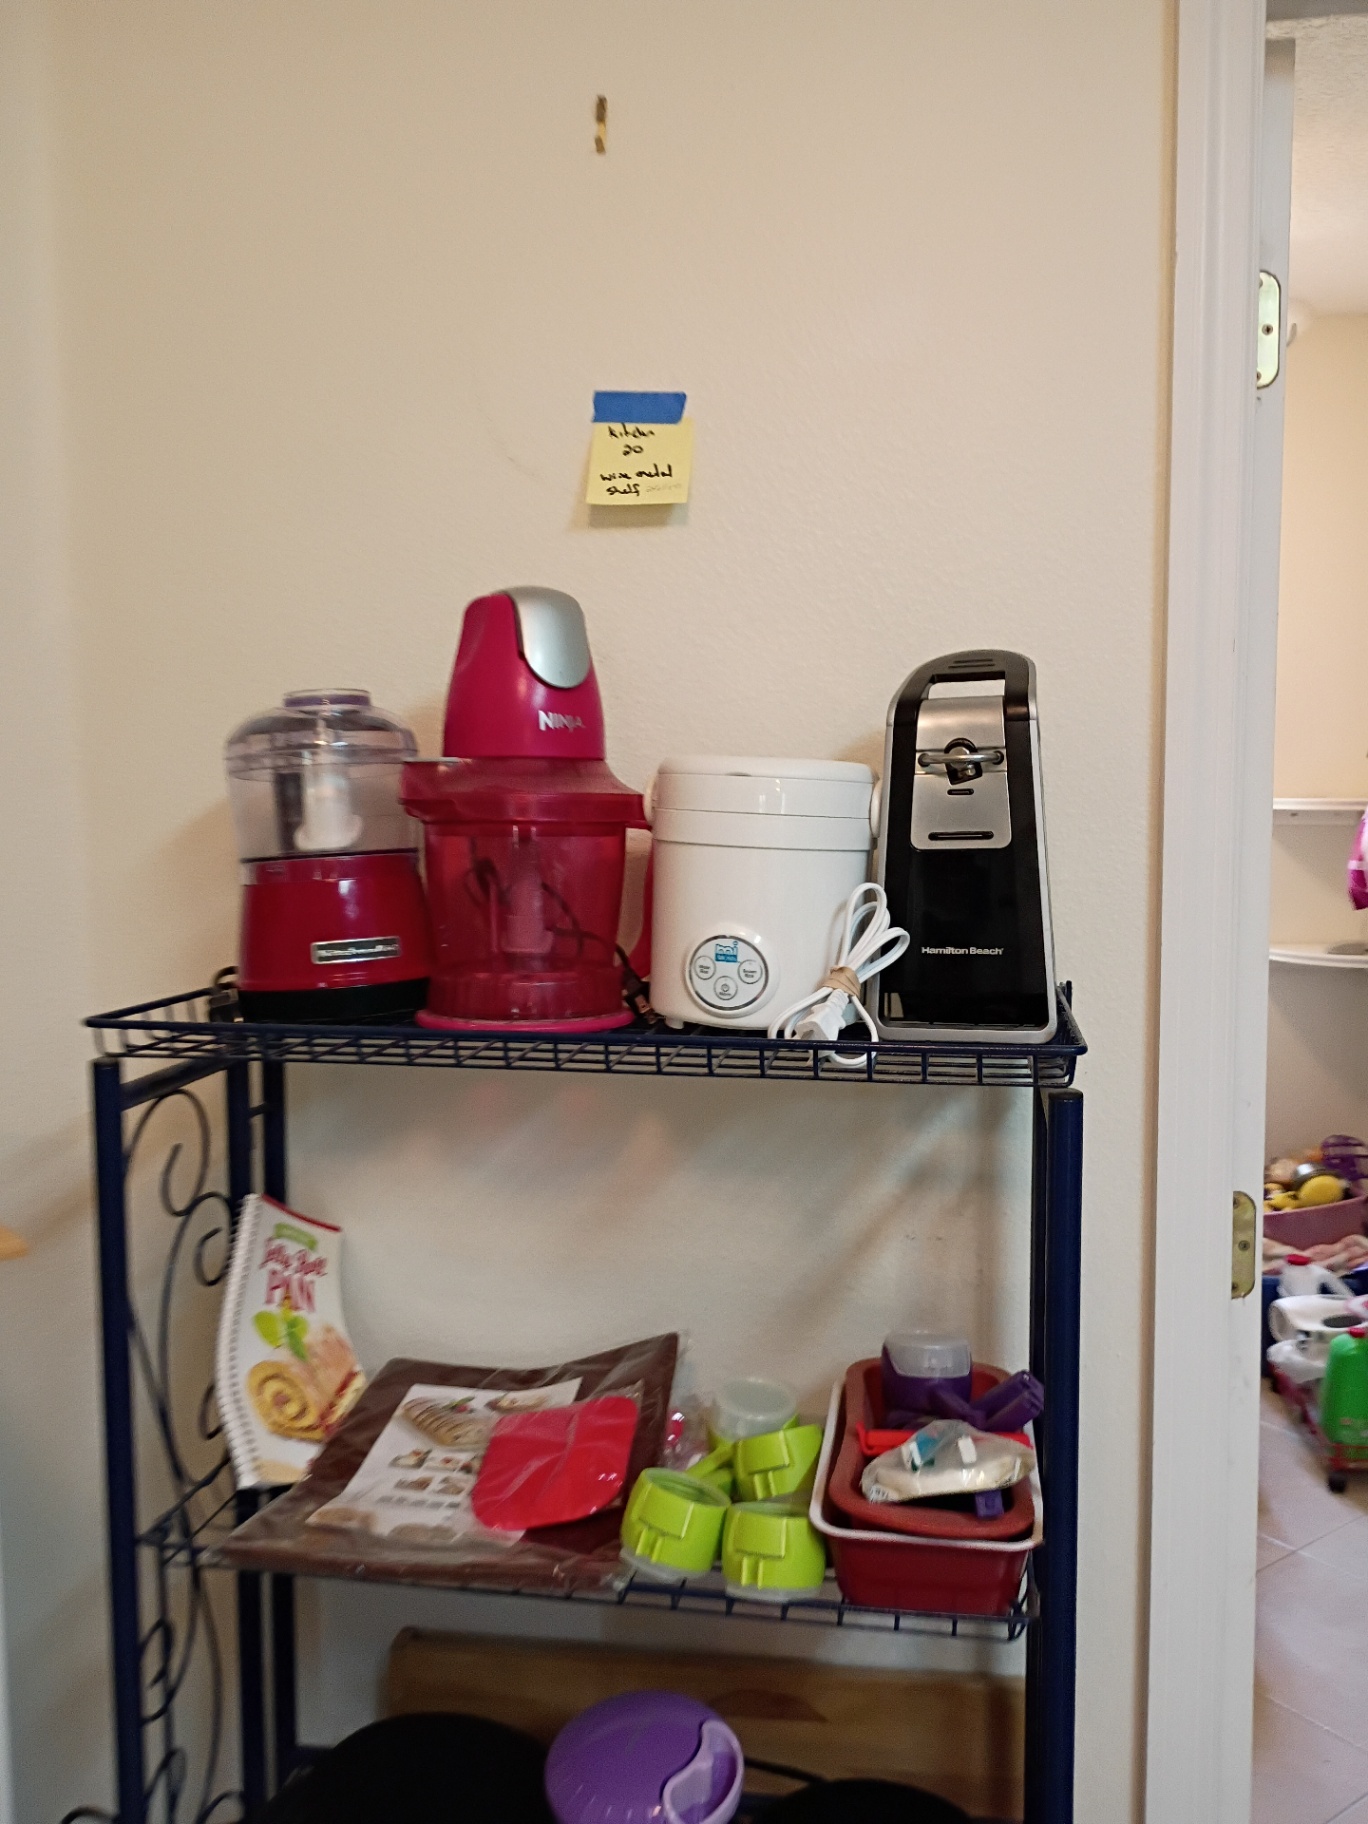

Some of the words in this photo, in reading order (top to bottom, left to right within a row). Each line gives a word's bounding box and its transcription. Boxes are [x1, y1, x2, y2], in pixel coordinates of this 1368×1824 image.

[635, 463, 673, 478] metal
[538, 710, 586, 732] NINJA
[921, 946, 969, 955] Hamilton
[969, 946, 1002, 955] Beach
